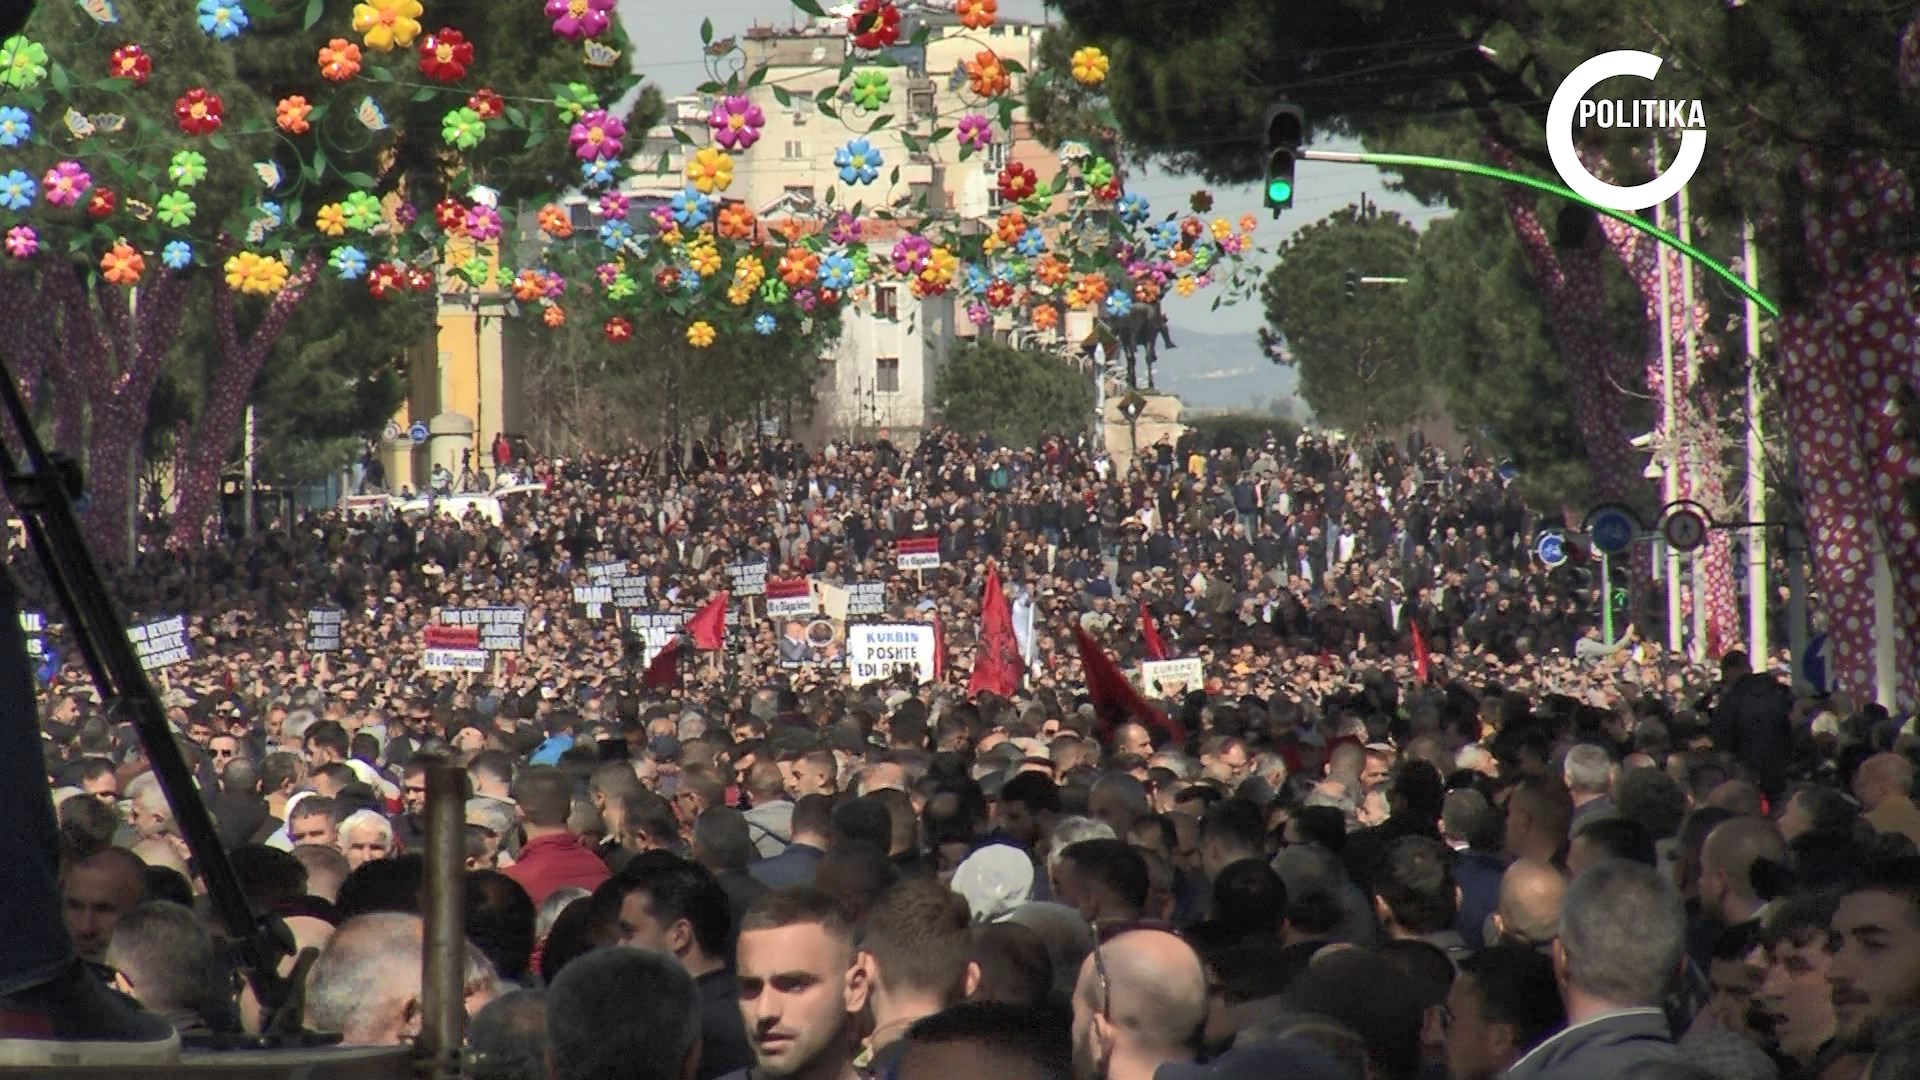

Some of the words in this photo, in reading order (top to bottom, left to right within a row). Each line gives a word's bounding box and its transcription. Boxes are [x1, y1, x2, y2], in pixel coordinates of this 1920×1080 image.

[574, 587, 613, 603] RAMA
[866, 631, 919, 643] KURBIN
[867, 646, 917, 660] POSHTE
[858, 663, 877, 677] EDI
[882, 662, 923, 677] RAA
